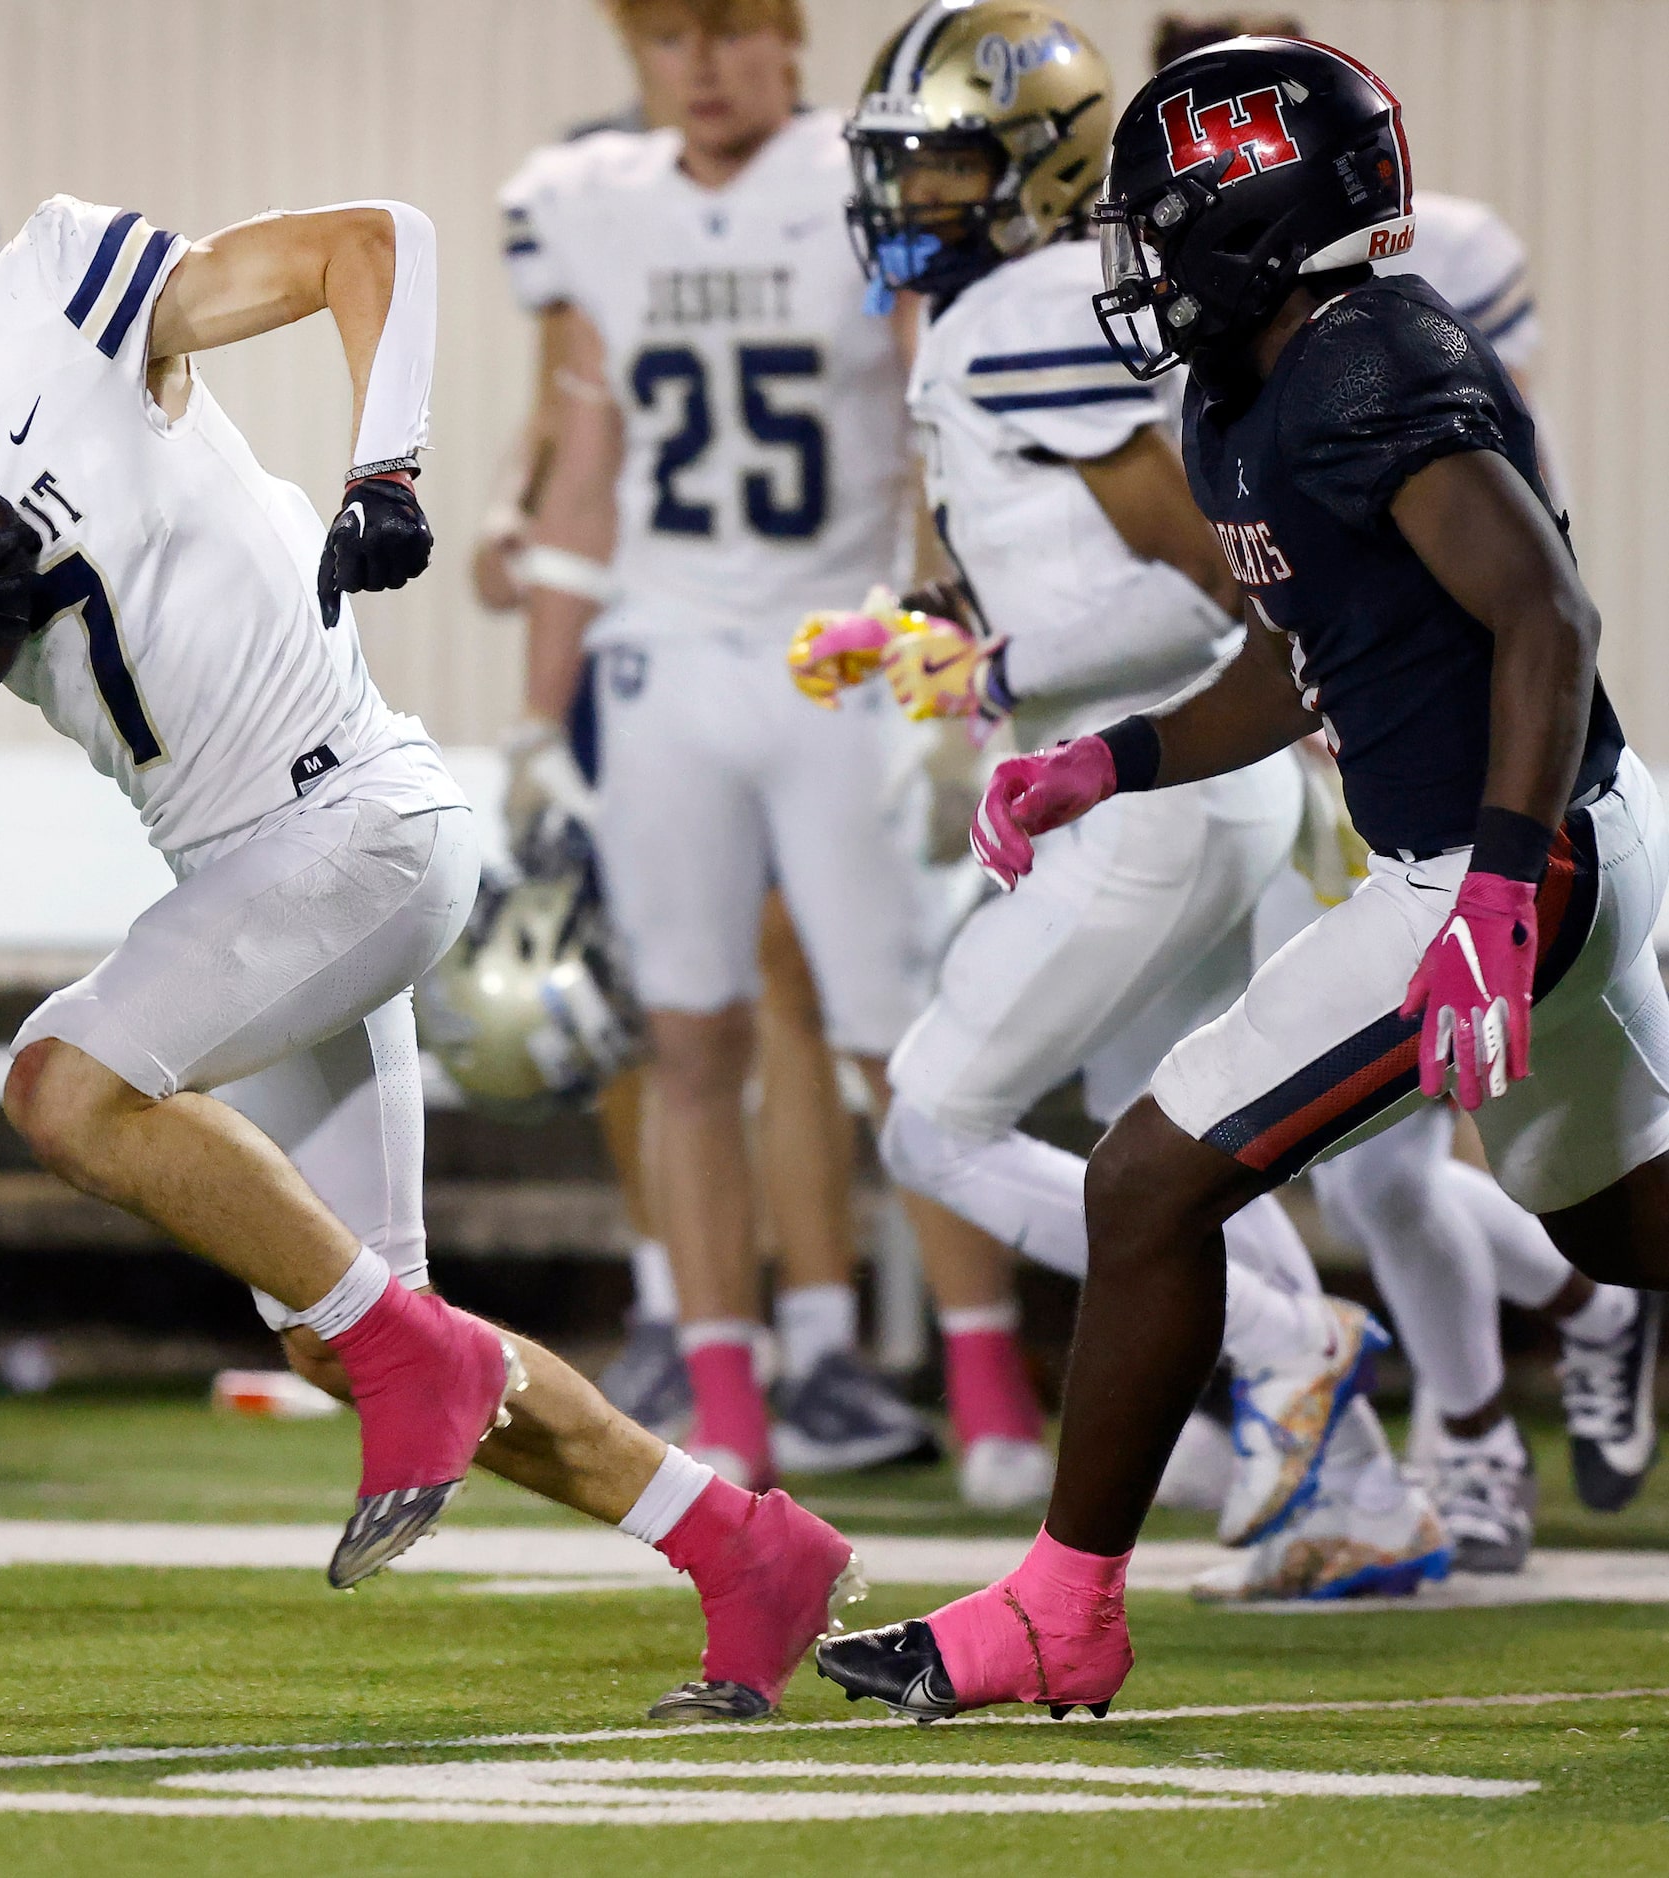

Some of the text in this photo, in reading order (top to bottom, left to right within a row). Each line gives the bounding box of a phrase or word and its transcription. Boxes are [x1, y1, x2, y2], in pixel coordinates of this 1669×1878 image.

[1157, 85, 1303, 190] LH
[632, 343, 828, 541] 25
[303, 755, 324, 774] M
